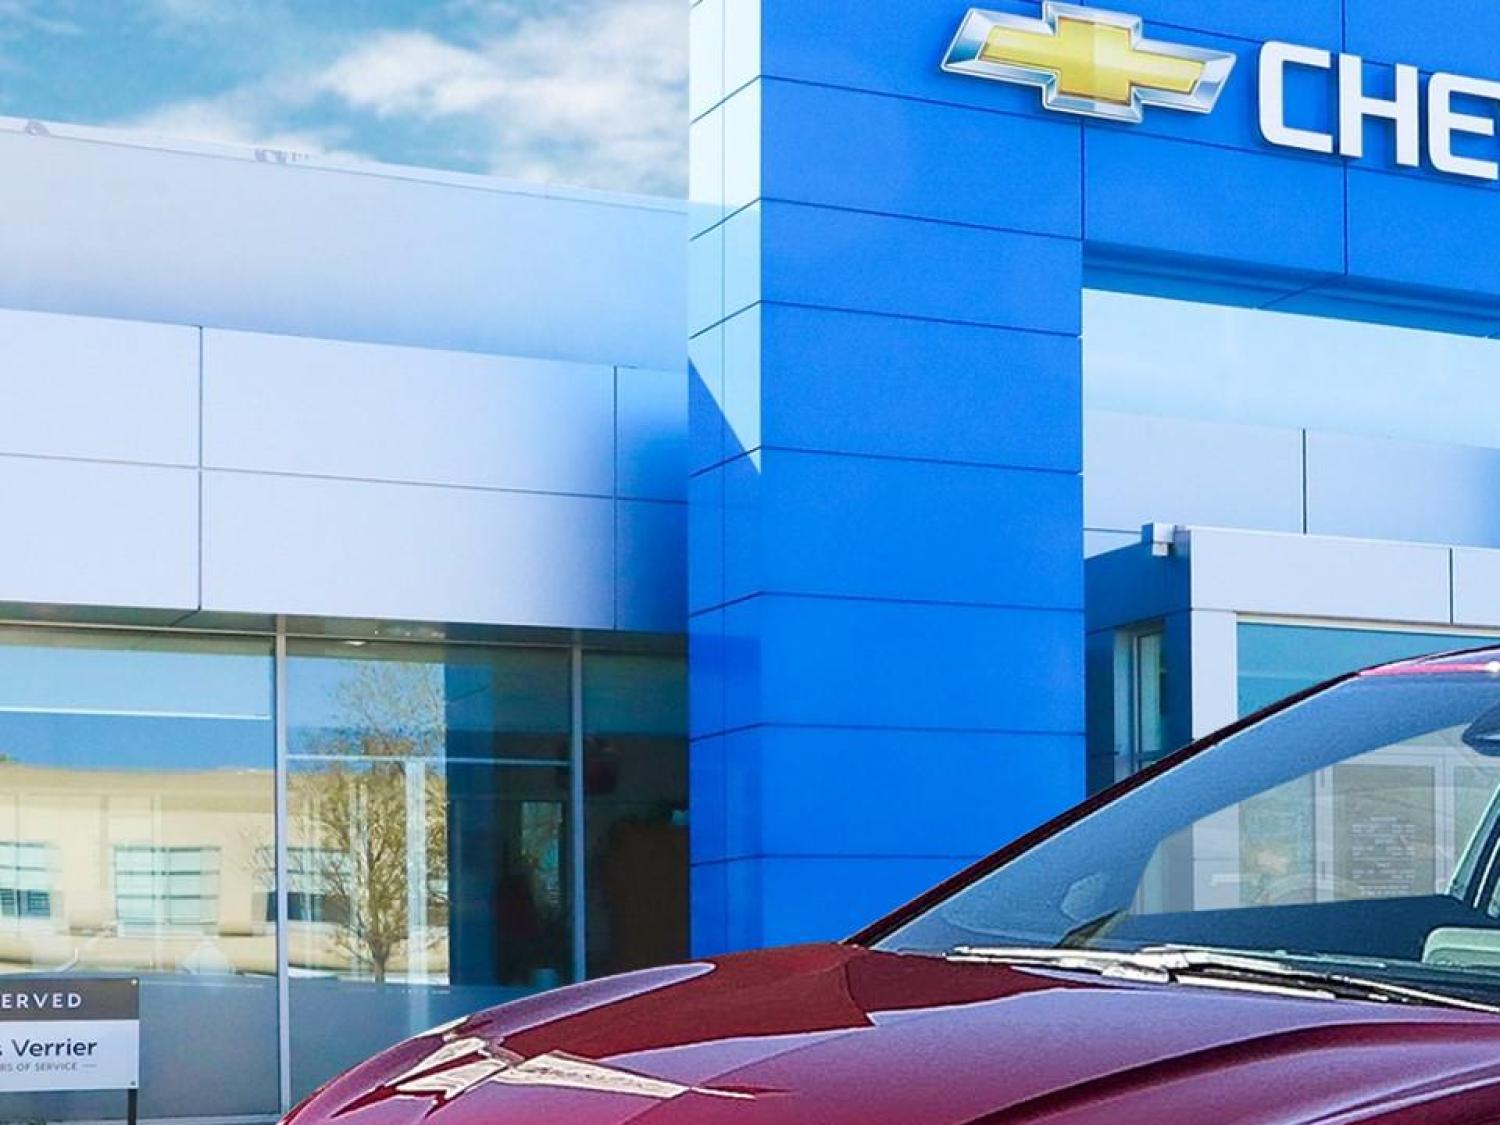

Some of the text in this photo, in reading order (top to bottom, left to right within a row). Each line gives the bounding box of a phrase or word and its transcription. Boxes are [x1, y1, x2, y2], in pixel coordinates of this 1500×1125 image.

[1, 993, 82, 1009] ERVED
[11, 1038, 97, 1057] Verrier
[16, 1062, 30, 1073] OF
[35, 1062, 77, 1073] SERVICE
